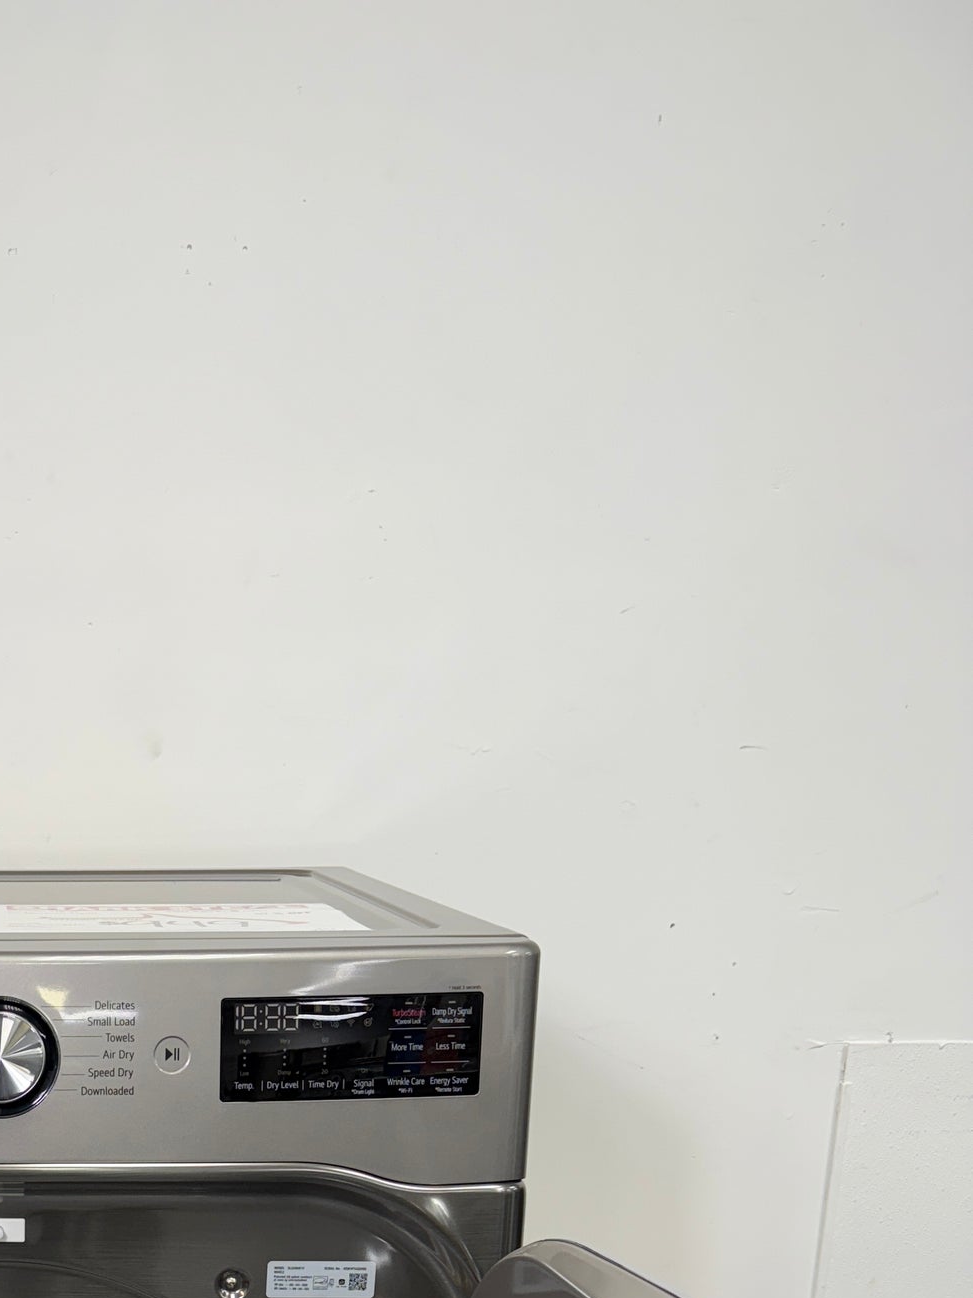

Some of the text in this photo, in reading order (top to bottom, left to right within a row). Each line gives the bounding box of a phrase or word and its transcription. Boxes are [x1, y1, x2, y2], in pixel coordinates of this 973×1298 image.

[94, 1000, 136, 1010] Delicates
[432, 1006, 473, 1017] Damp Dry Signal
[87, 1016, 136, 1026] Small Load
[105, 1032, 135, 1042] Towels
[391, 1042, 424, 1051] More Time
[435, 1041, 466, 1051] Less Time
[102, 1049, 135, 1061] Air Dry
[87, 1067, 134, 1080] Speed Dry
[234, 1081, 254, 1090] Temp.
[266, 1079, 299, 1090] Dry Level
[308, 1079, 339, 1089] Time Dry
[353, 1078, 375, 1088] Signal
[387, 1077, 425, 1086] Wrinkle Care
[429, 1076, 469, 1086] Energy Saver
[80, 1086, 135, 1096] Downloaded
